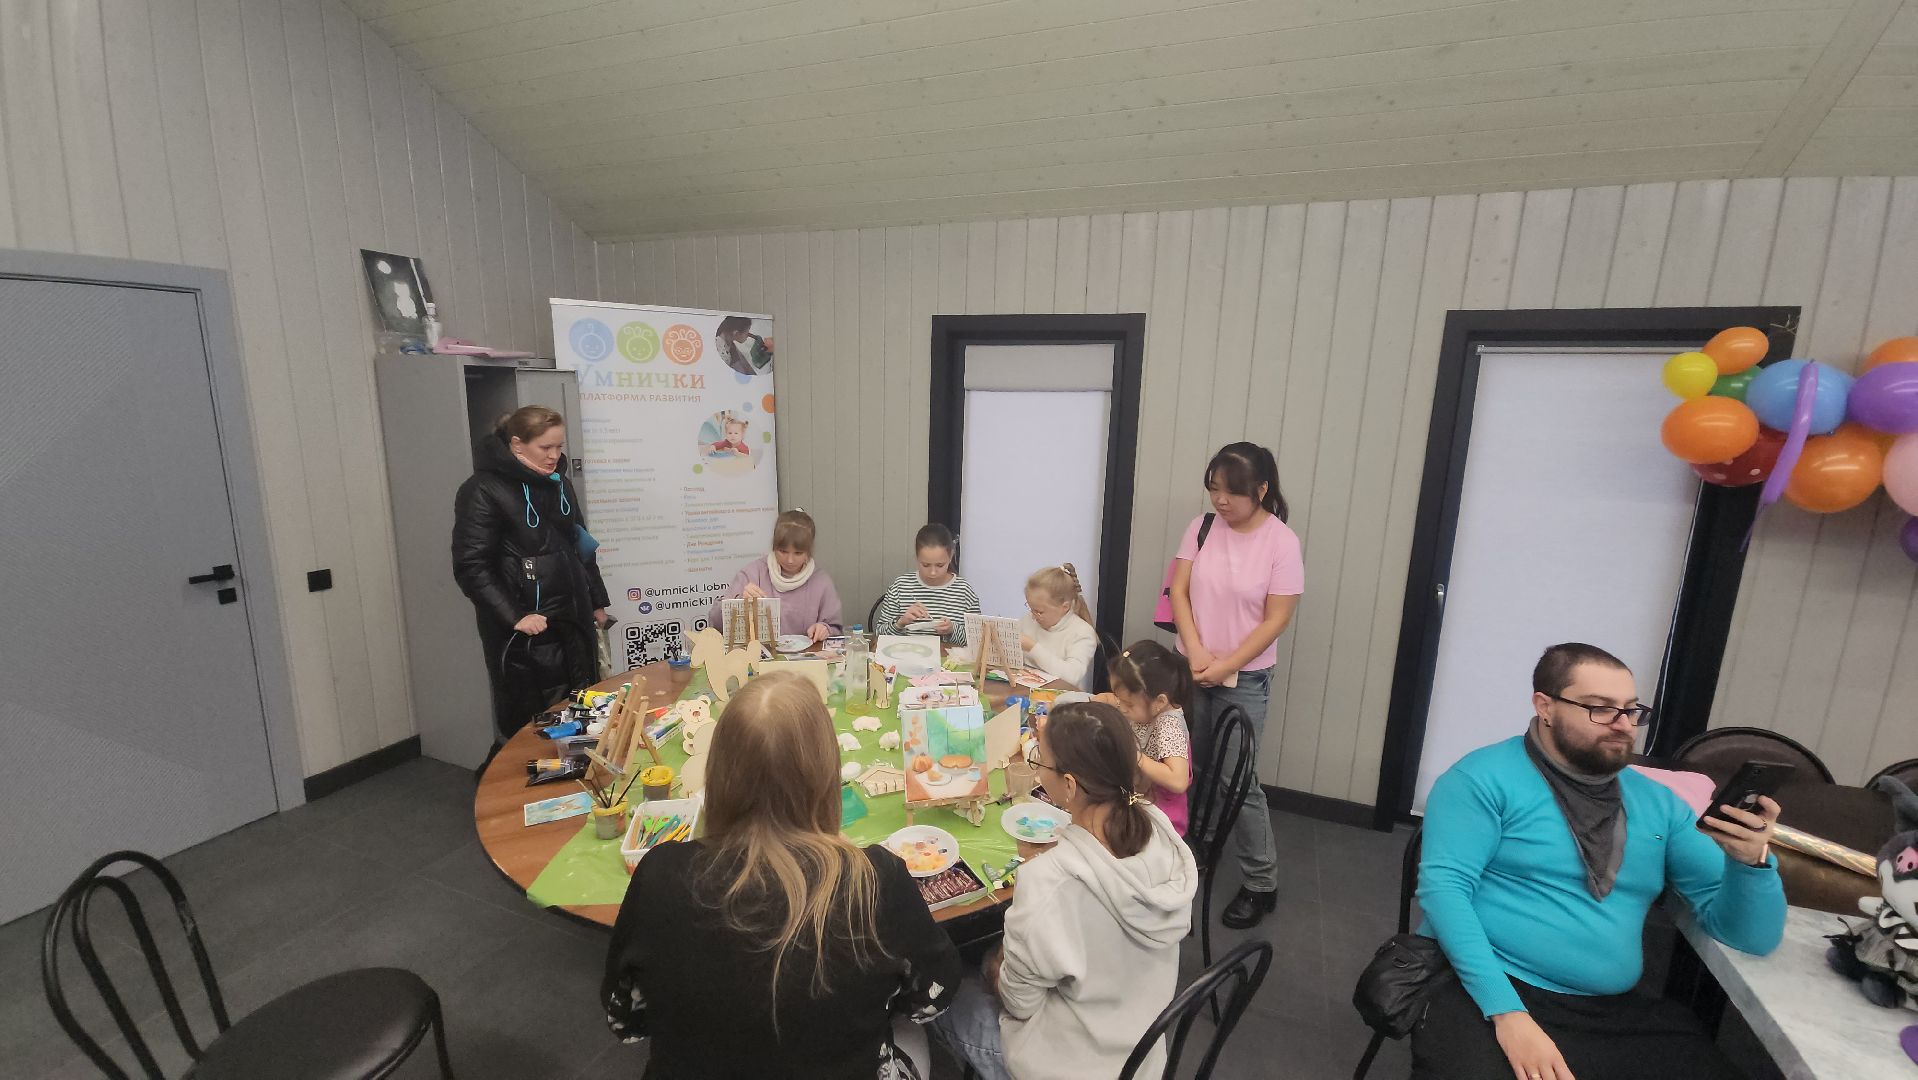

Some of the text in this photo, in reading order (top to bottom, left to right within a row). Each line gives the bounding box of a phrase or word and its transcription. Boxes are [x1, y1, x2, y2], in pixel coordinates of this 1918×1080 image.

[571, 363, 706, 389] Умнички
[579, 391, 701, 404] ПЛАТФОРМА РАЗВИТИЯ
